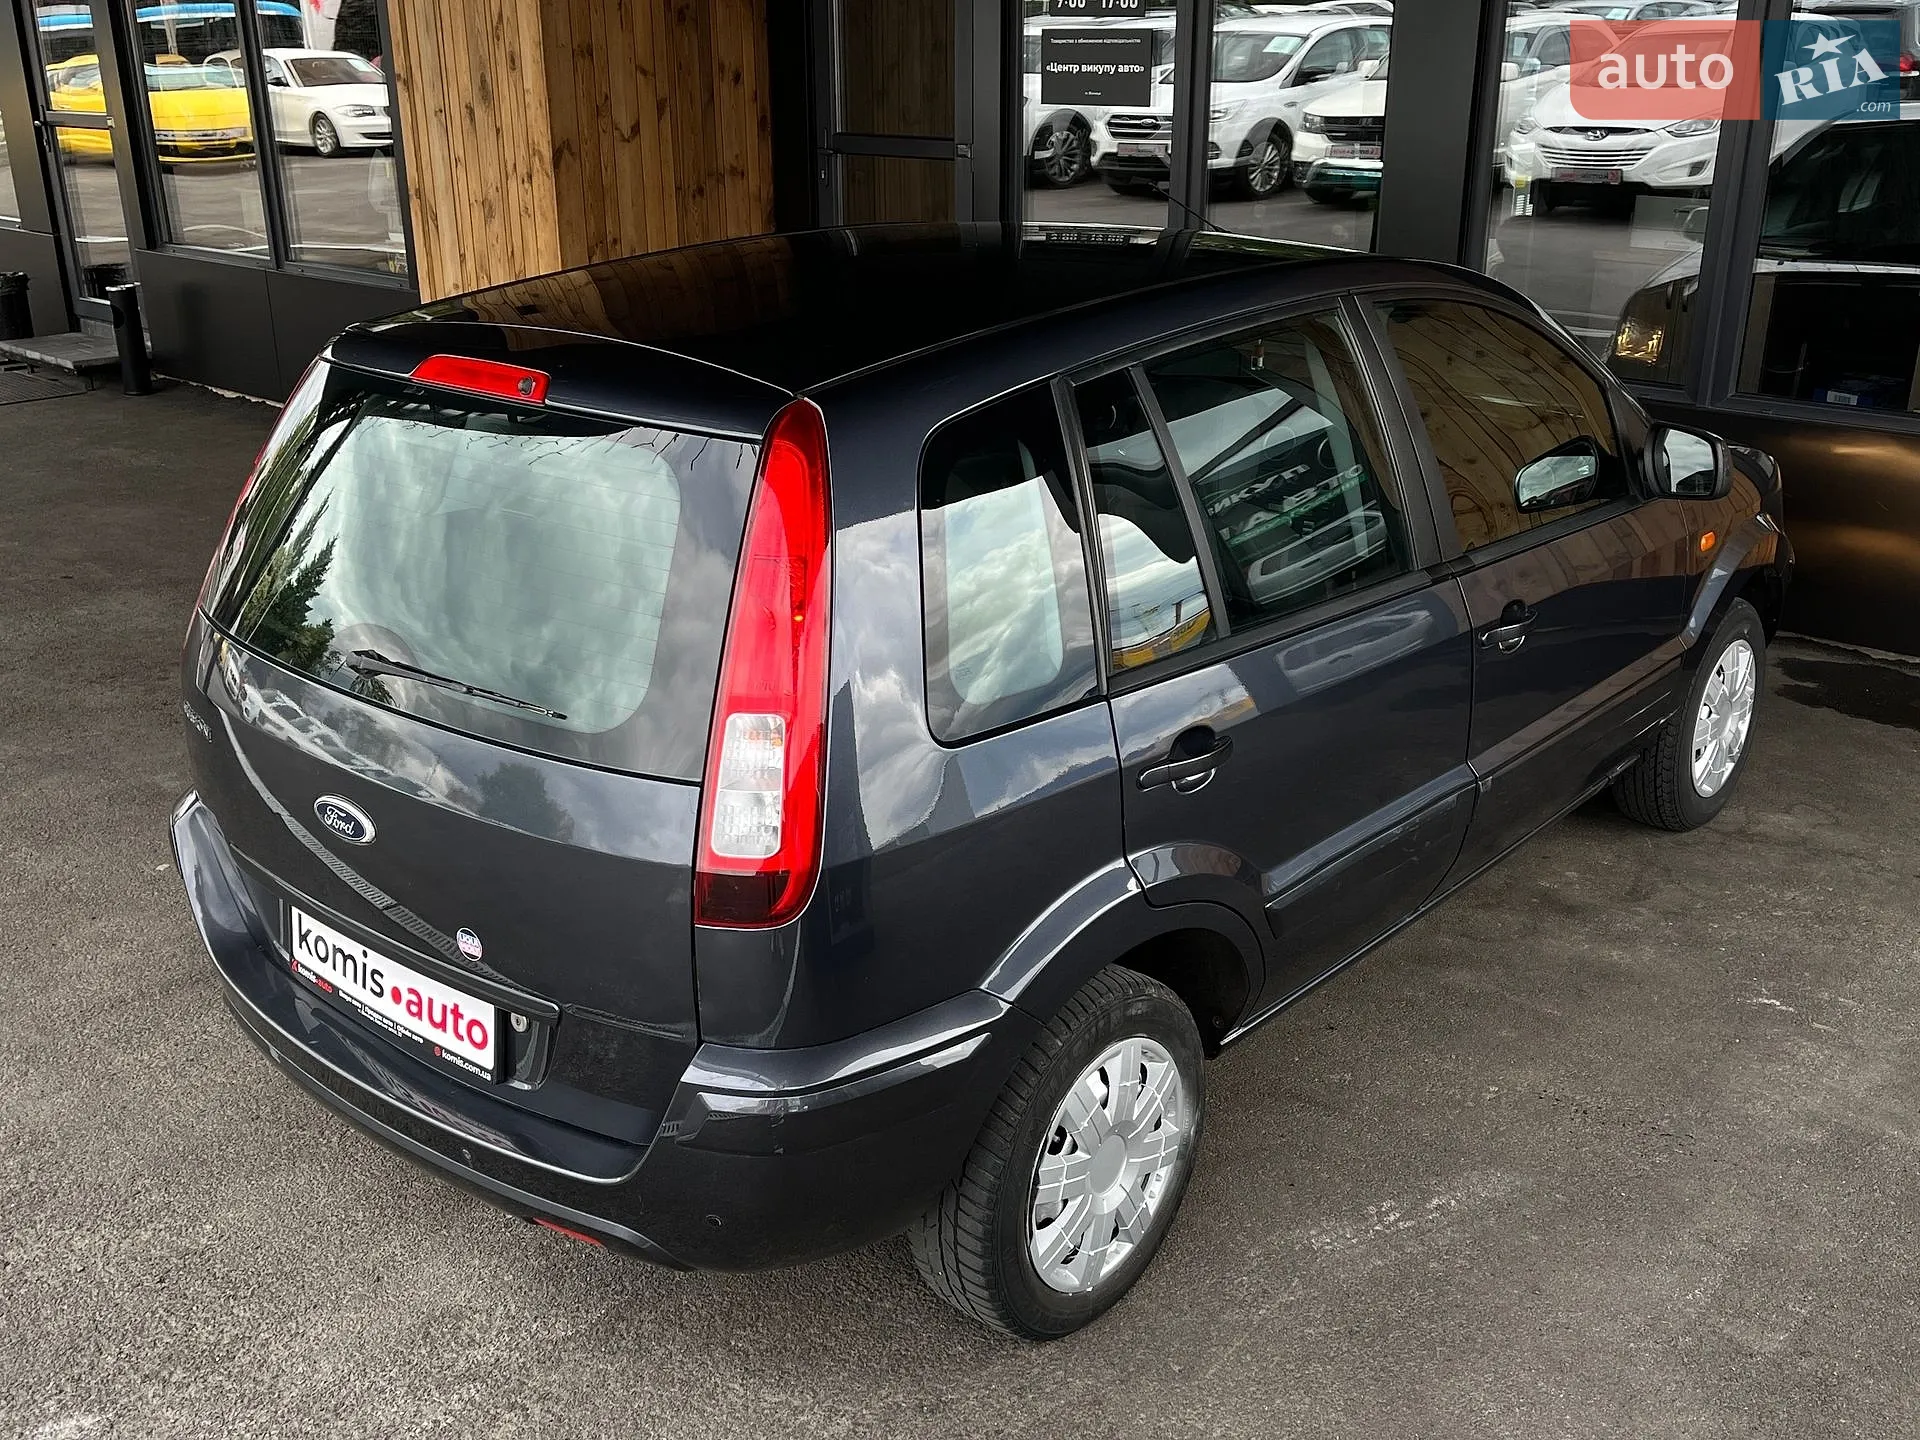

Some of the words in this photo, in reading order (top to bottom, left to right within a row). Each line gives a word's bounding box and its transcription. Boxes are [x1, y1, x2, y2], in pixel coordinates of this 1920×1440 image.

[1046, 62, 1080, 75] «Центр
[1081, 64, 1116, 75] викупу
[1118, 64, 1145, 73] авто»
[324, 806, 355, 835] Ford
[441, 1050, 492, 1081] komis.com.ua
